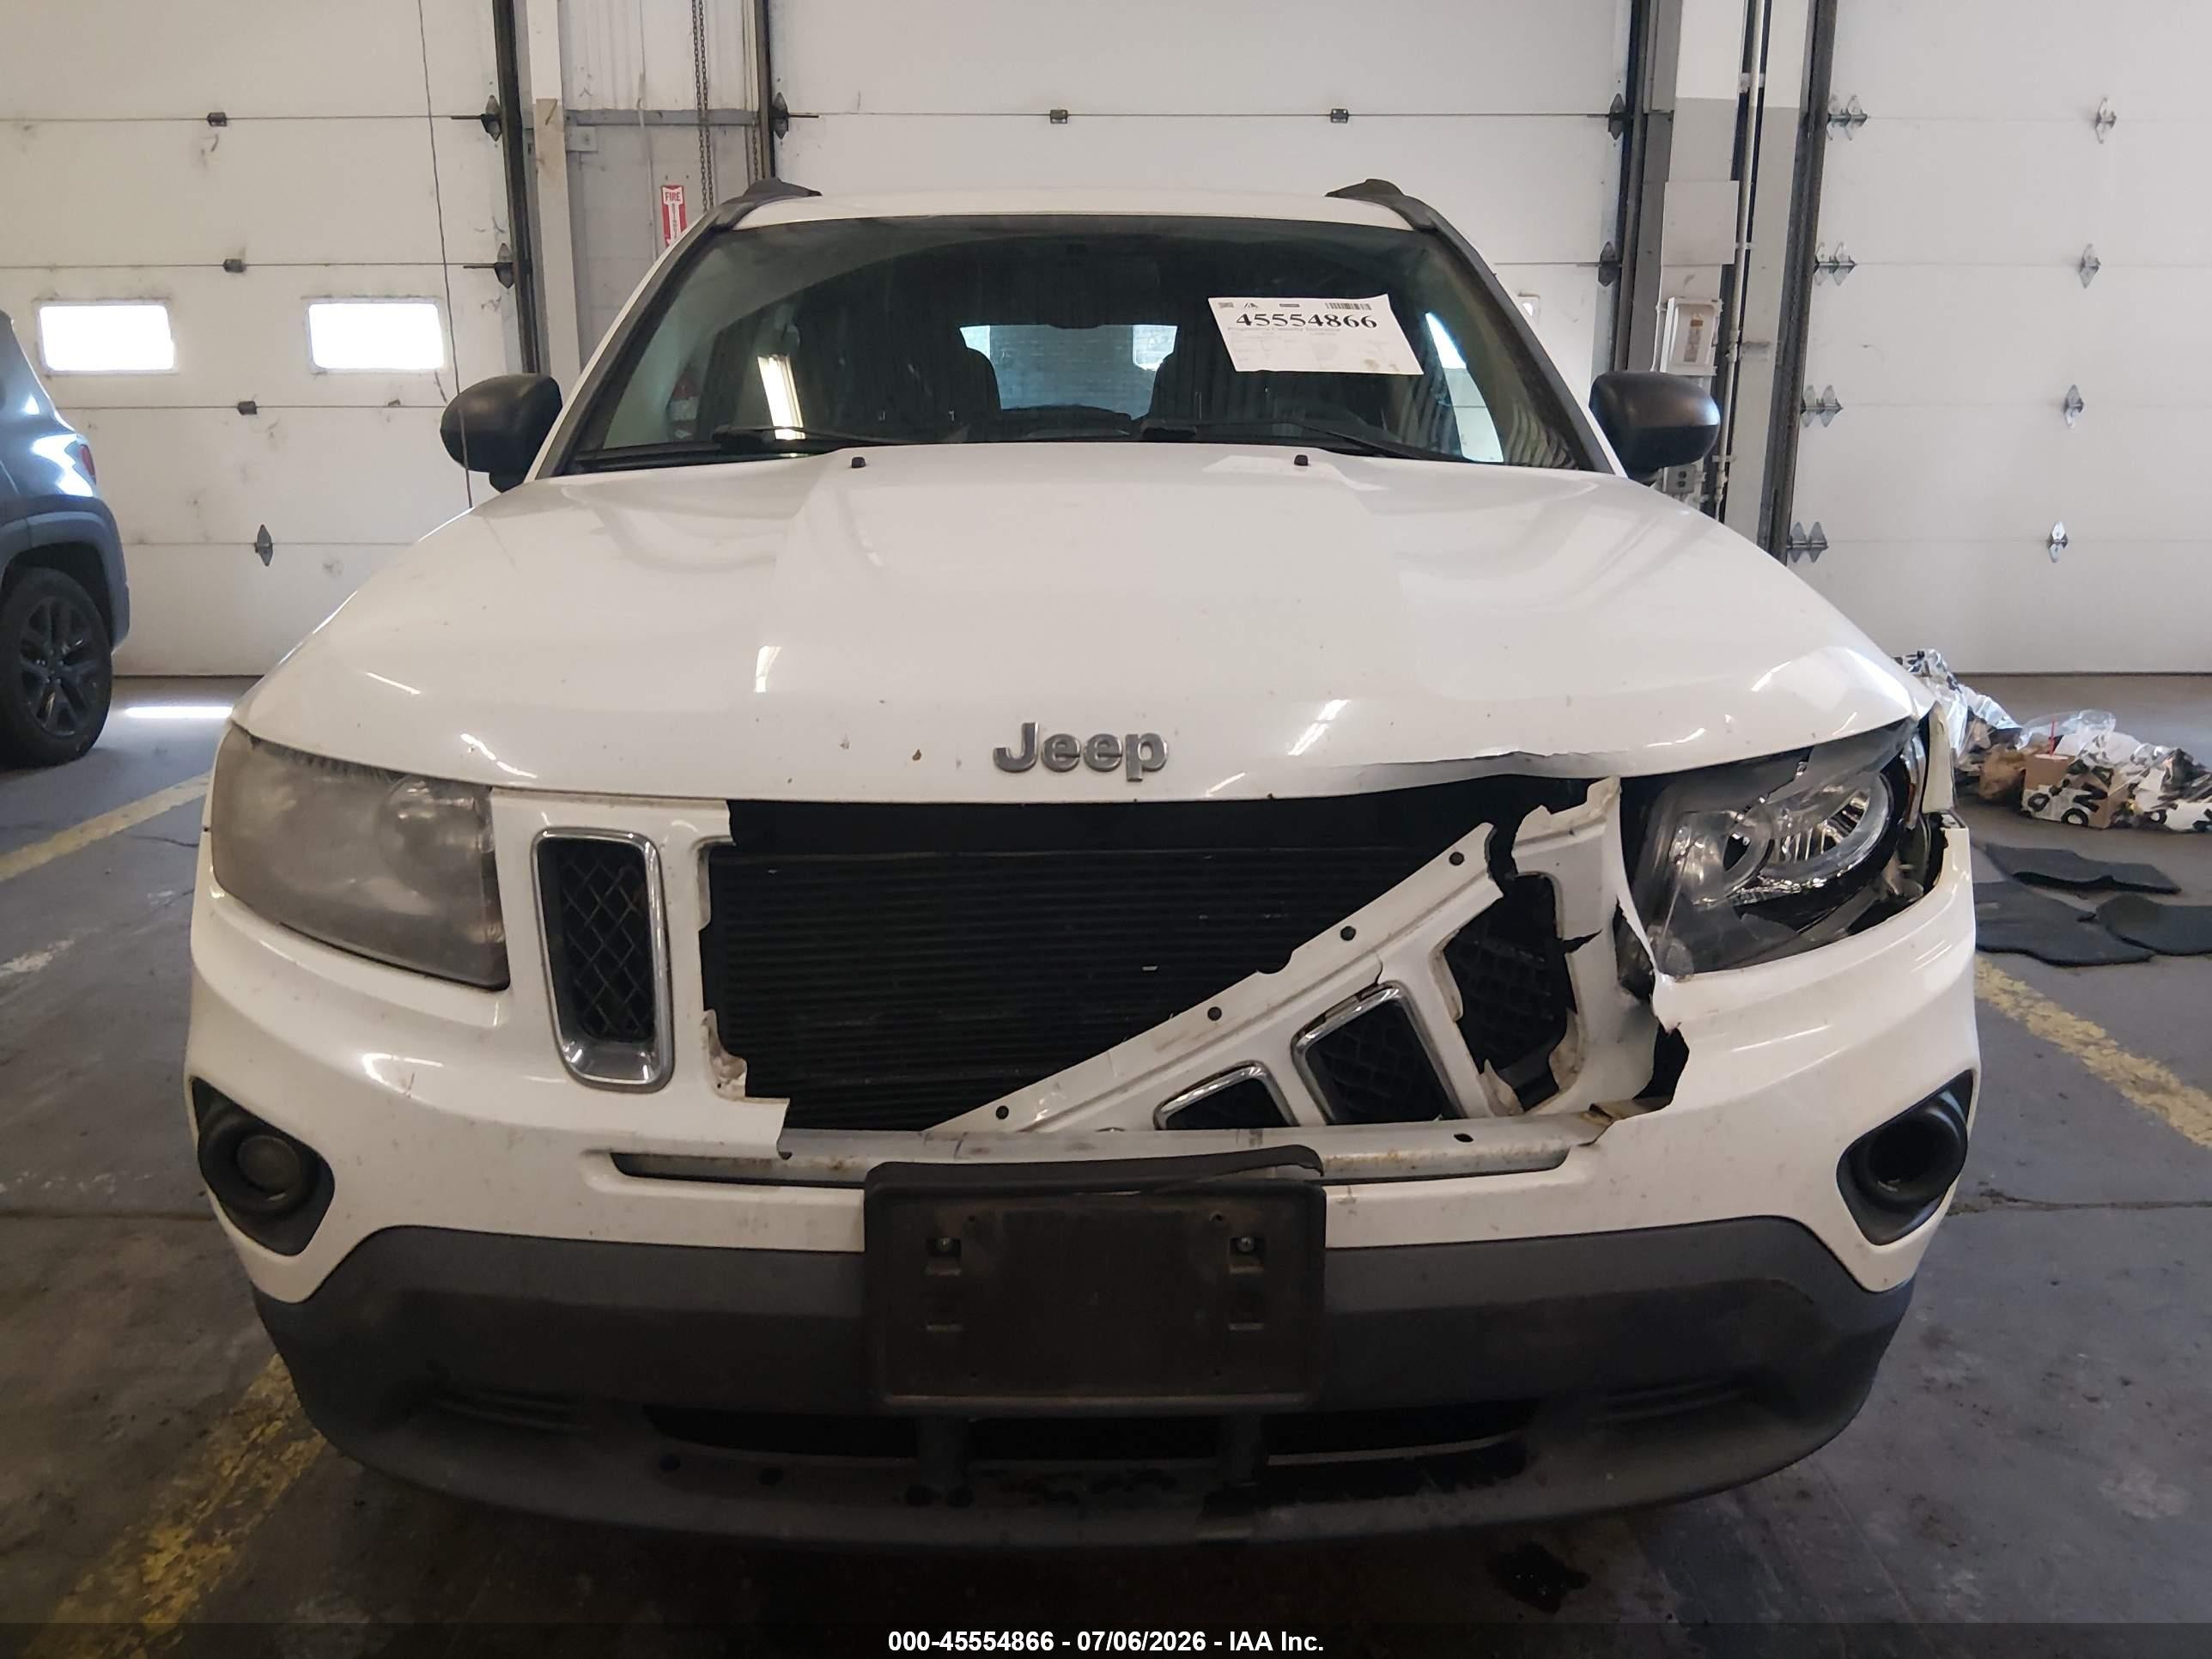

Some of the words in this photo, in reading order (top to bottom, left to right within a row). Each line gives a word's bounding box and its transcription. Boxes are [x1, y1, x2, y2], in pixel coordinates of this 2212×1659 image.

[665, 191, 681, 202] FIRE
[1236, 313, 1377, 328] 45554866
[994, 721, 1169, 782] Jeep
